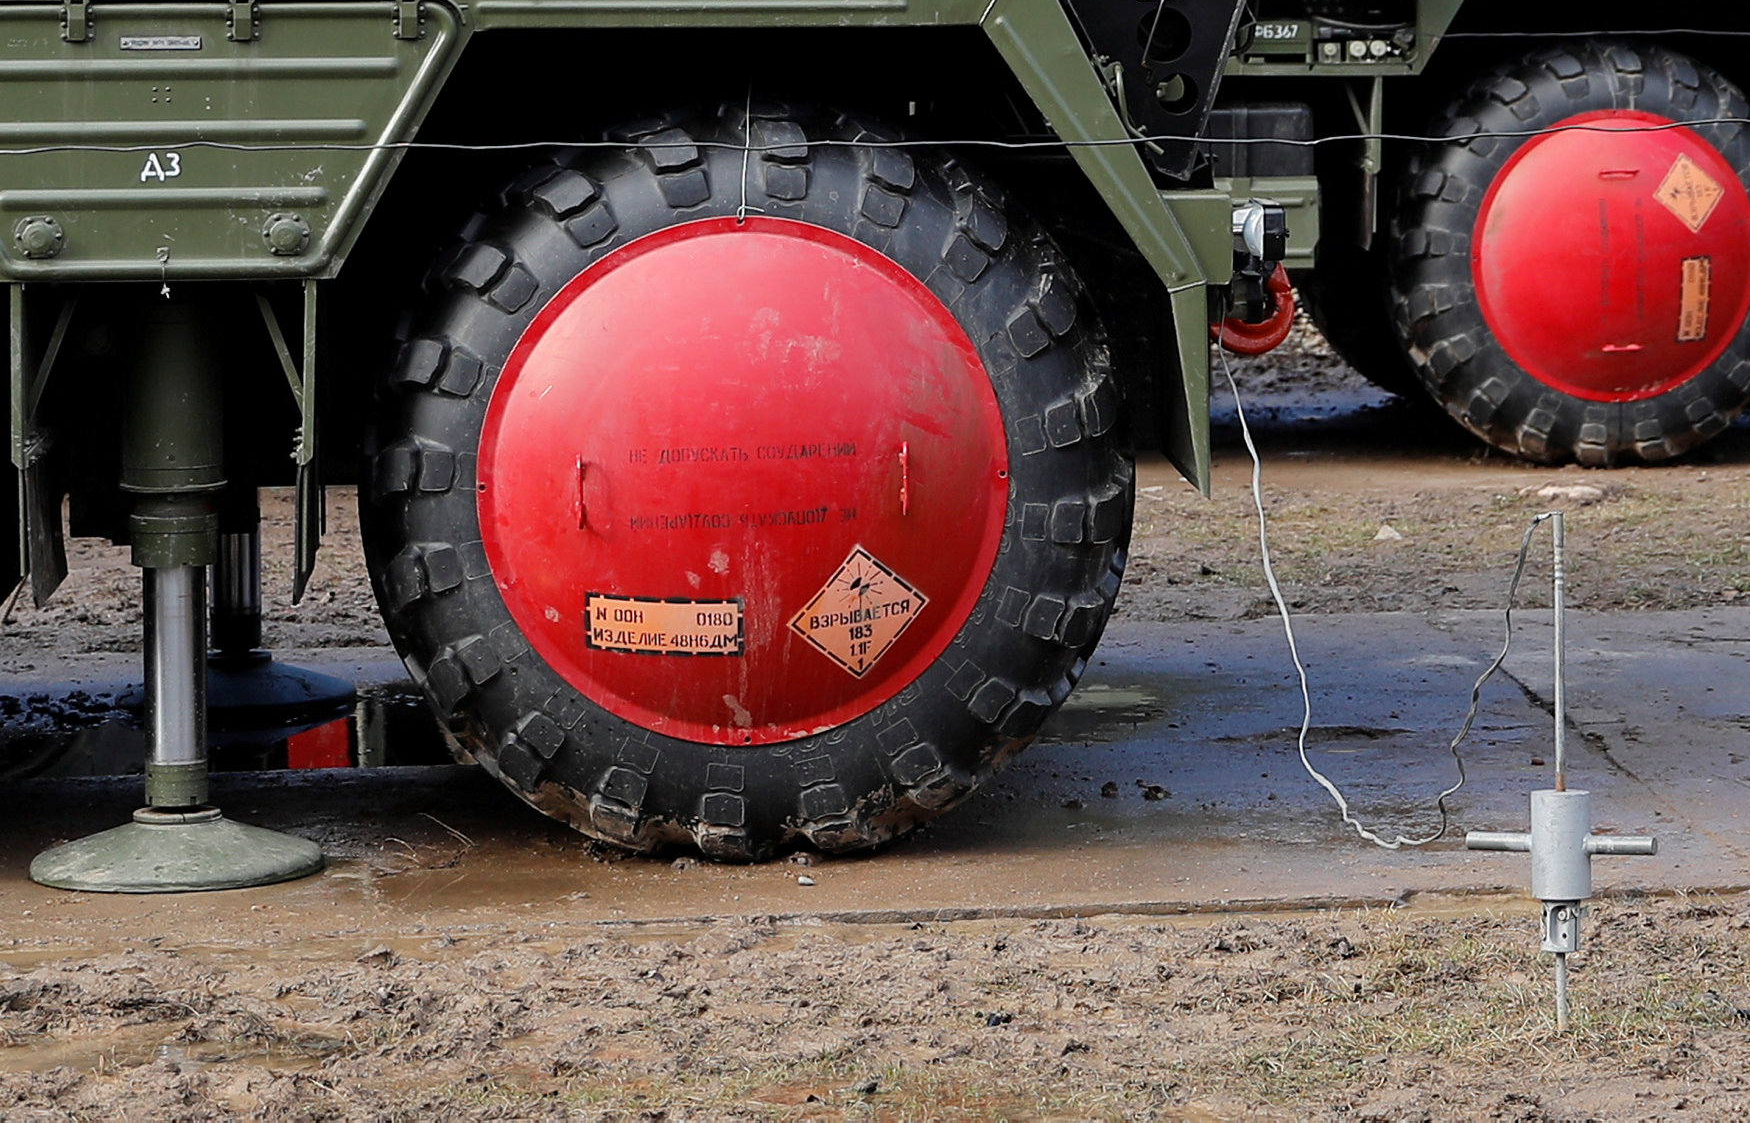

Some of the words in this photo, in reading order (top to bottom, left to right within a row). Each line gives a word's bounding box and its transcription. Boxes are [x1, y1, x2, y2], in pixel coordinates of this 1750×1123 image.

[629, 448, 648, 464] НЕ
[658, 447, 749, 466] ДОПУСКАТЬ
[696, 612, 733, 627] 0180
[810, 598, 910, 630] ВЗРЫВАЕТСЯ
[593, 627, 668, 647] ИЗДЕЛИЕ
[670, 633, 738, 649] 48Н6ДМ
[848, 624, 873, 641] 183
[849, 640, 872, 657] 1.1F
[857, 656, 864, 671] 1
